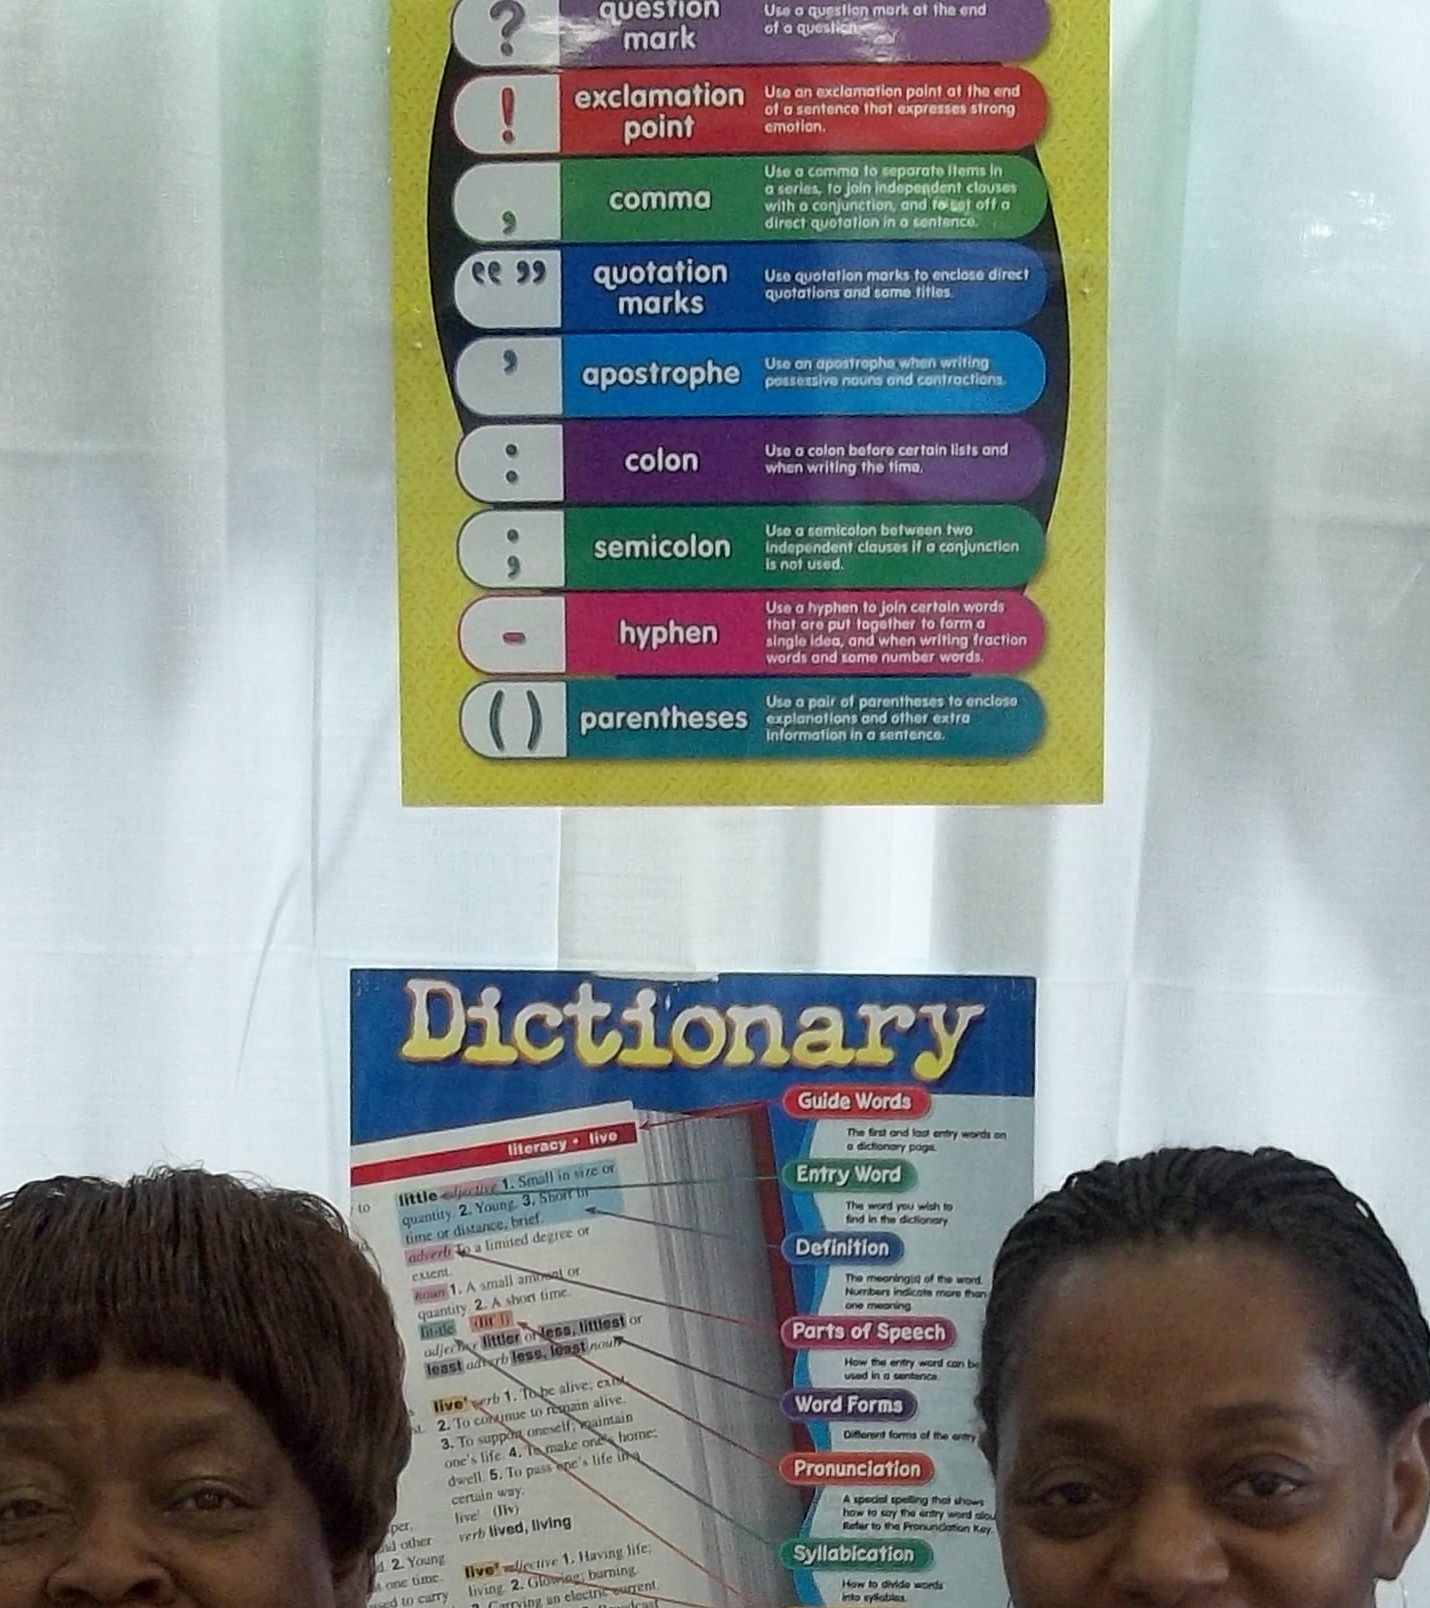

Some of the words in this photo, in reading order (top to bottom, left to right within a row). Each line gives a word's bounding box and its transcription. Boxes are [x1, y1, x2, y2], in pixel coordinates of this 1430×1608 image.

[599, 0, 719, 22] question
[624, 25, 695, 50] mark
[575, 82, 744, 108] exclamation
[765, 85, 791, 98] Use
[795, 88, 813, 98] an
[817, 84, 902, 97] exclamation
[906, 84, 942, 100] point
[947, 85, 961, 97] at
[968, 84, 990, 97] the
[993, 85, 1020, 97] end
[625, 114, 694, 145] point
[610, 191, 710, 209] comma
[594, 259, 727, 290] quotation
[619, 290, 703, 314] marks
[583, 360, 739, 390] apostrophe
[626, 447, 697, 471] colon
[765, 444, 791, 457] Use
[795, 447, 804, 457] a
[808, 444, 845, 456] colon
[849, 443, 894, 456] before
[898, 444, 947, 456] certain
[951, 443, 978, 456] lists
[982, 442, 1008, 455] and
[766, 461, 803, 473] when
[807, 460, 856, 476] writing
[862, 459, 884, 473] the
[890, 461, 923, 473] time.
[595, 534, 730, 558] semicolon
[621, 620, 717, 649] hyphen
[581, 706, 747, 735] parentheses
[402, 979, 984, 1079] Dictionary
[798, 1092, 851, 1109] Guide
[855, 1092, 911, 1109] Words
[508, 1136, 567, 1157] literacy
[589, 1132, 617, 1145] live
[798, 1165, 850, 1186] Entry
[855, 1165, 902, 1183] Word
[796, 1238, 889, 1255] Definition
[793, 1322, 844, 1339] Parts
[851, 1323, 872, 1339] of
[877, 1323, 945, 1343] Speech
[795, 1396, 841, 1412] Word
[848, 1396, 902, 1412] Forms
[795, 1460, 920, 1476] Pronunciation
[489, 1521, 528, 1537] lived,
[532, 1517, 571, 1531] living
[794, 1545, 913, 1564] Syllabication
